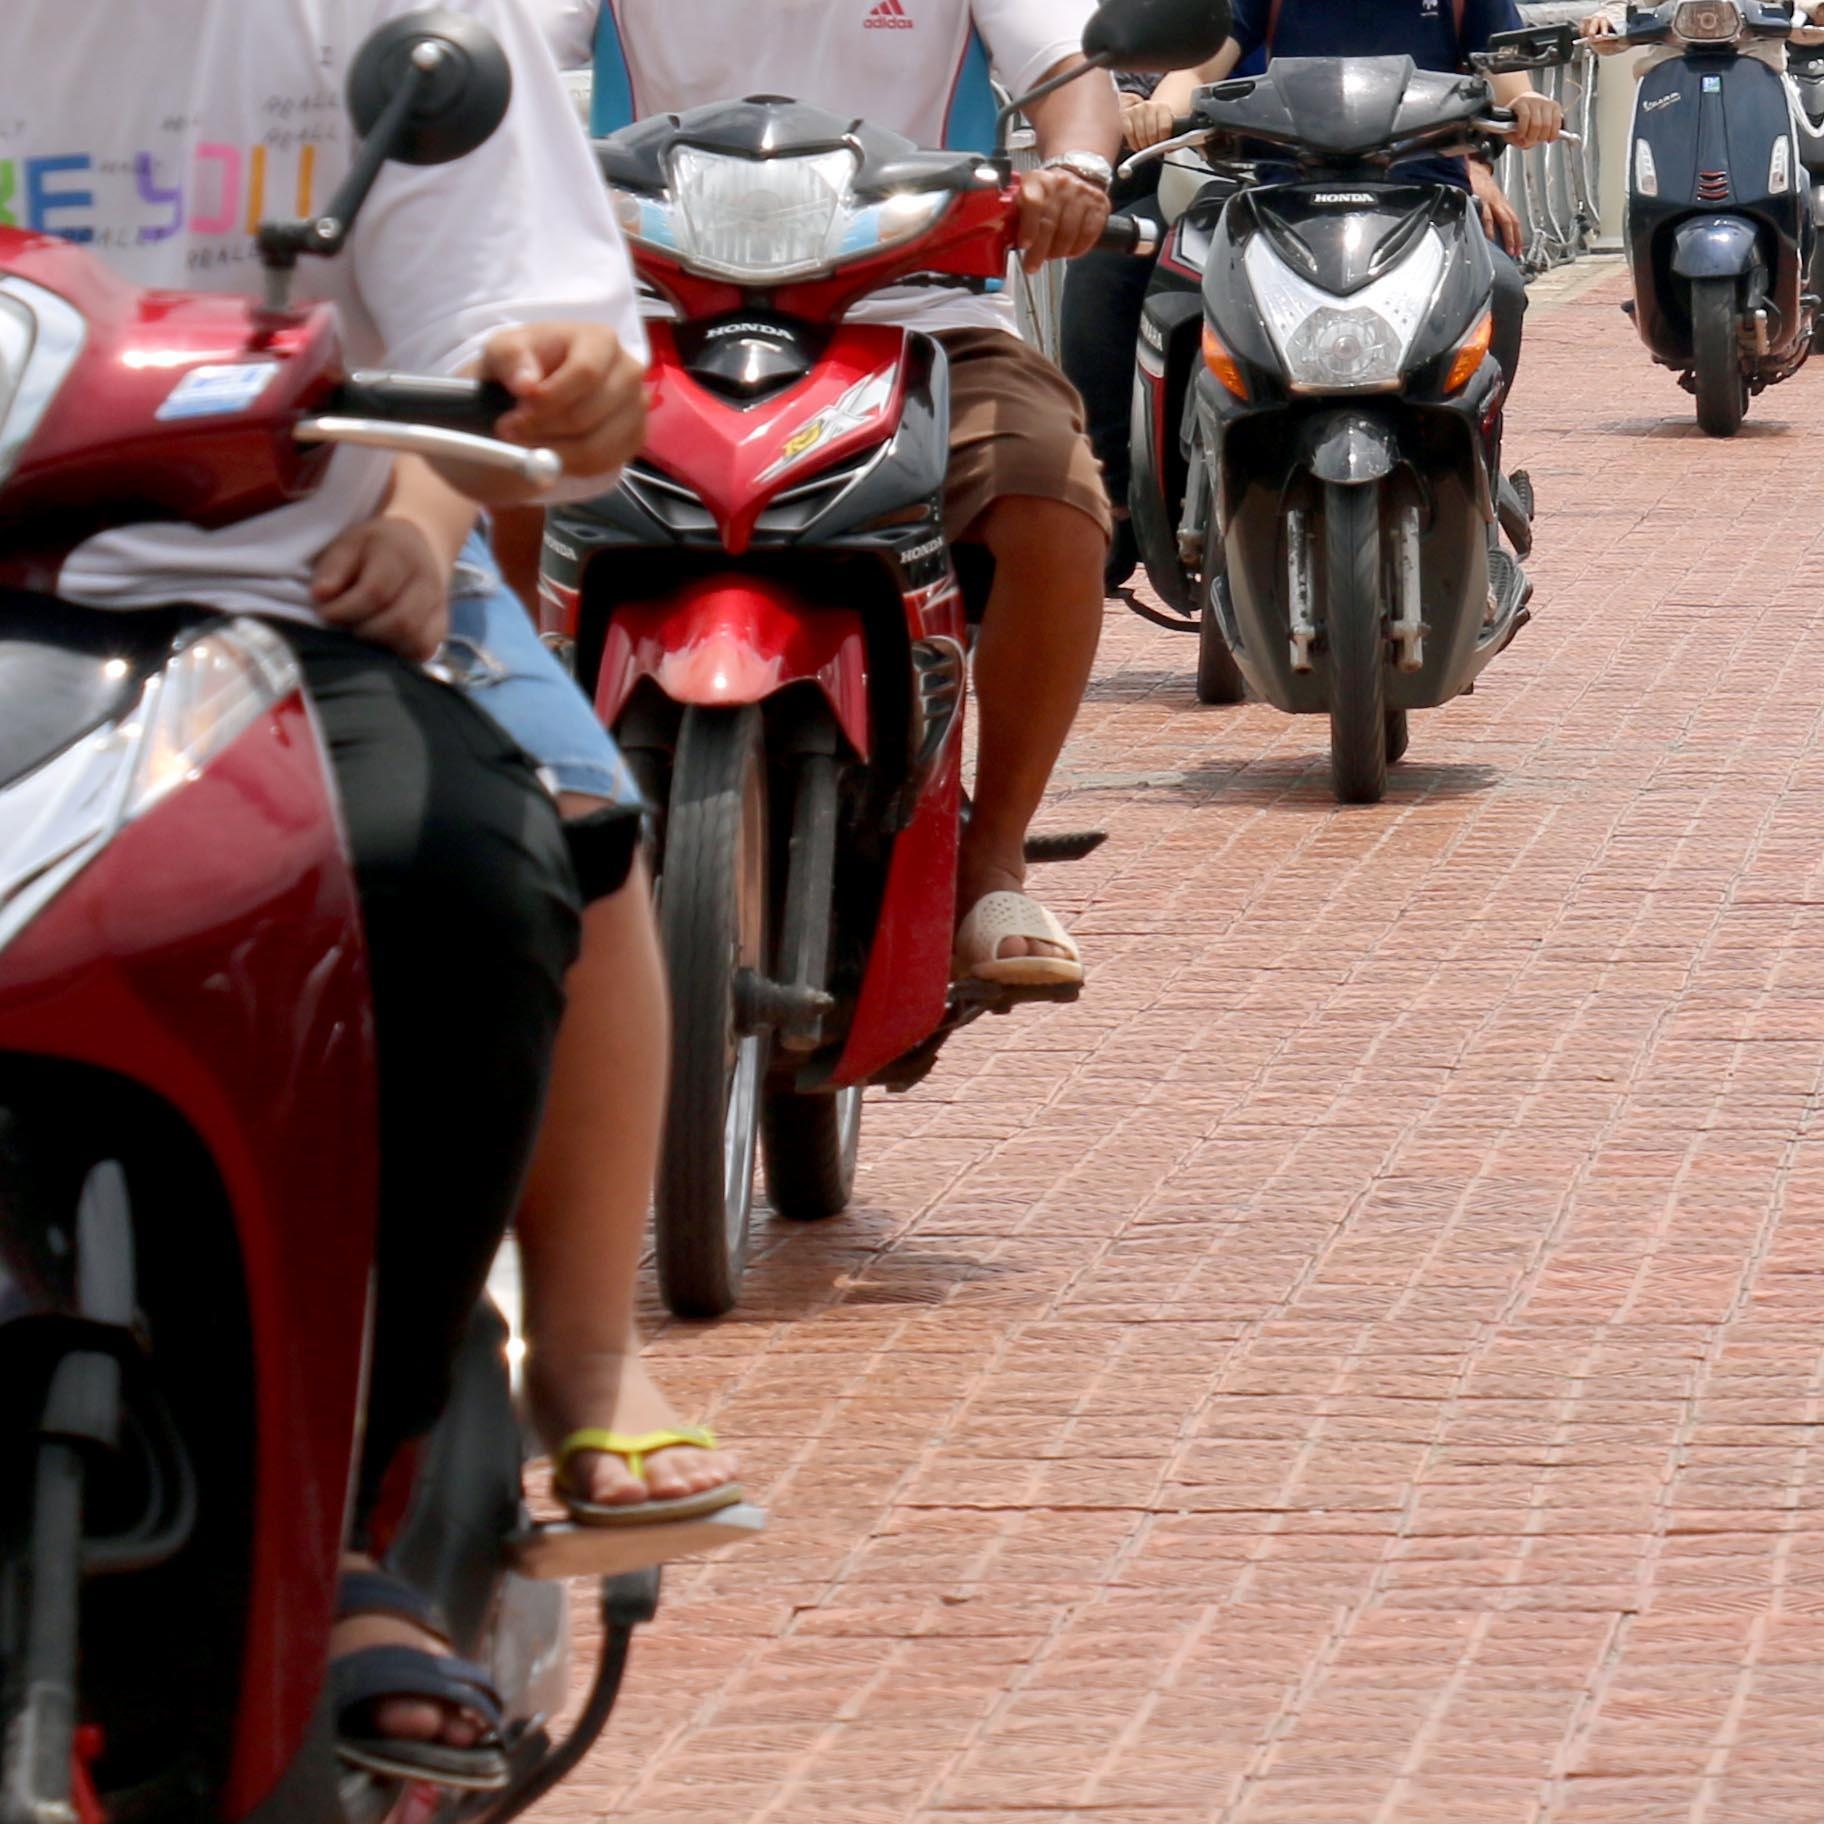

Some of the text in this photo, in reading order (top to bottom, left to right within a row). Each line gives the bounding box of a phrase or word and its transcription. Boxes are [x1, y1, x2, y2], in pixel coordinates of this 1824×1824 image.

[863, 15, 913, 29] adidas
[1314, 192, 1376, 202] HONDA
[705, 323, 794, 341] HONDA
[900, 536, 943, 564] HONDA
